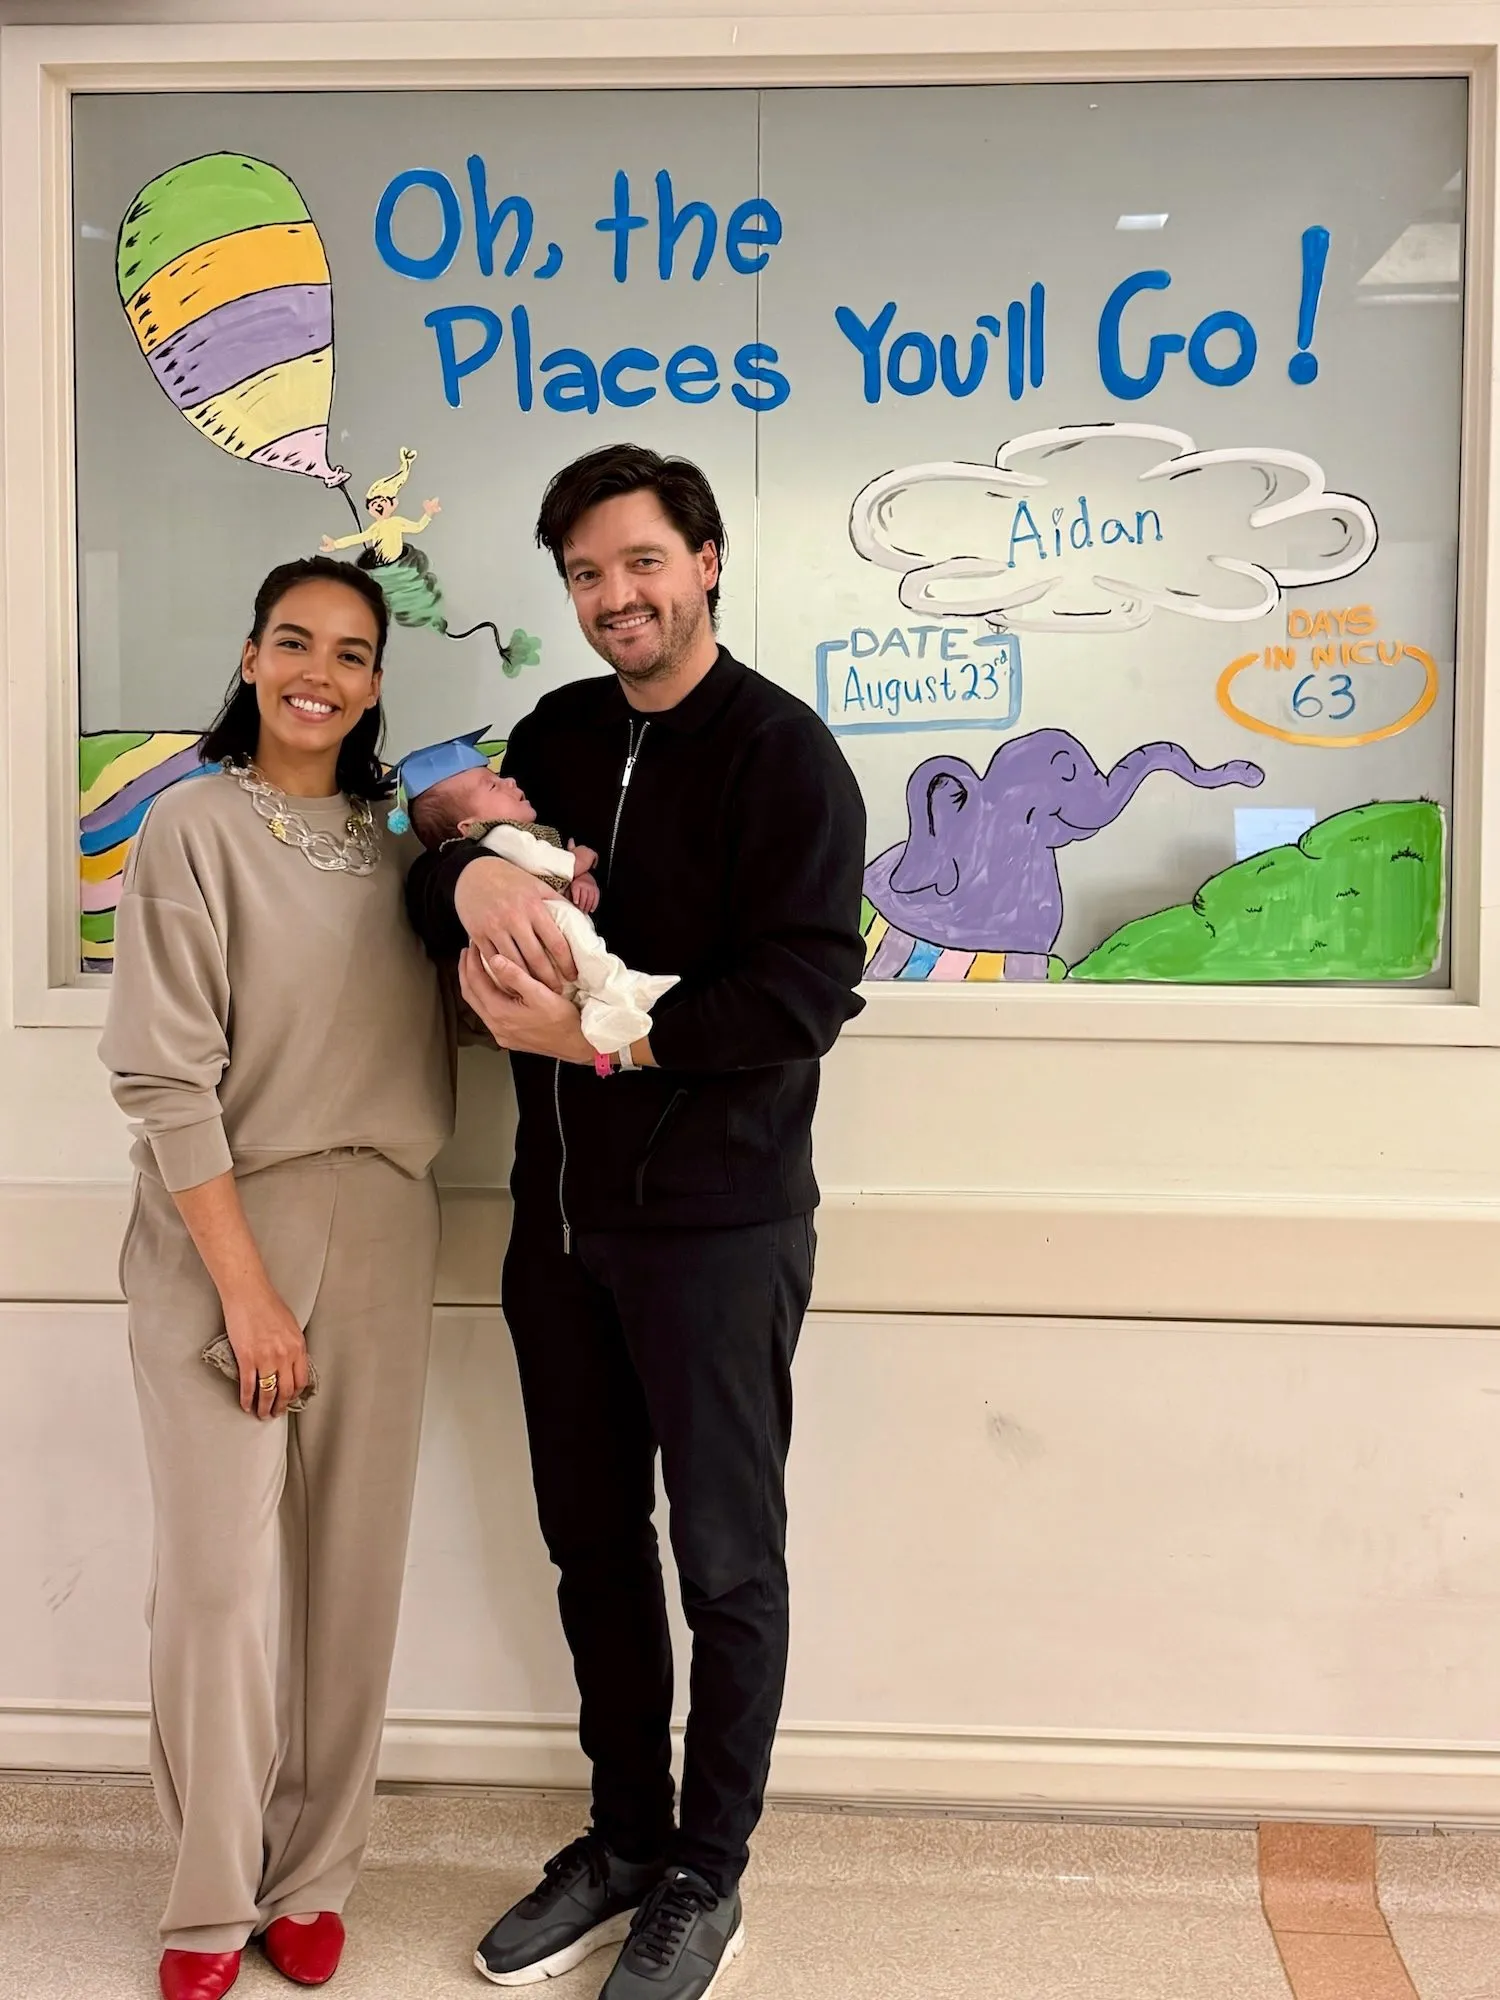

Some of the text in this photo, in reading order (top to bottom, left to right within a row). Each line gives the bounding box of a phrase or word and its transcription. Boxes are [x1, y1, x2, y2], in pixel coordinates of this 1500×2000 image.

[374, 154, 782, 283] Oh, the
[424, 304, 791, 414] Places
[835, 281, 1045, 403] You'll
[1008, 496, 1163, 568] Aidan
[849, 625, 968, 660] DATE
[1287, 604, 1377, 639] DAYS
[1264, 640, 1404, 671] IN NICU
[843, 666, 956, 716] August
[1293, 673, 1356, 720] 63
